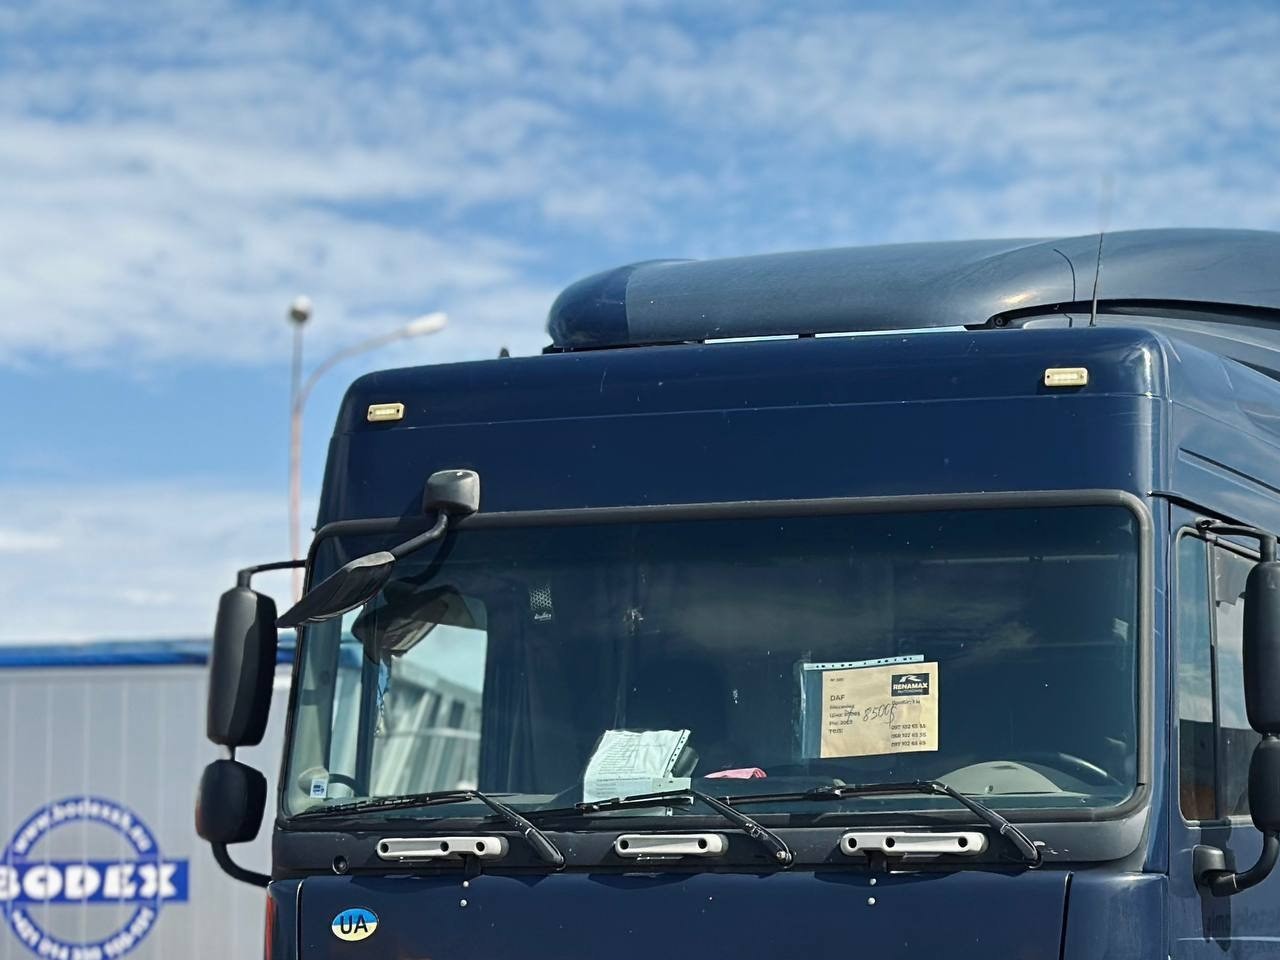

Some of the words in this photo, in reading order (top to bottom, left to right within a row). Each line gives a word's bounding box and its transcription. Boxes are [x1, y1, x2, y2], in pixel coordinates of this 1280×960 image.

[892, 682, 928, 691] RENAMAX
[830, 694, 846, 702] DAF
[0, 863, 177, 900] BODEX
[339, 914, 369, 935] UA
